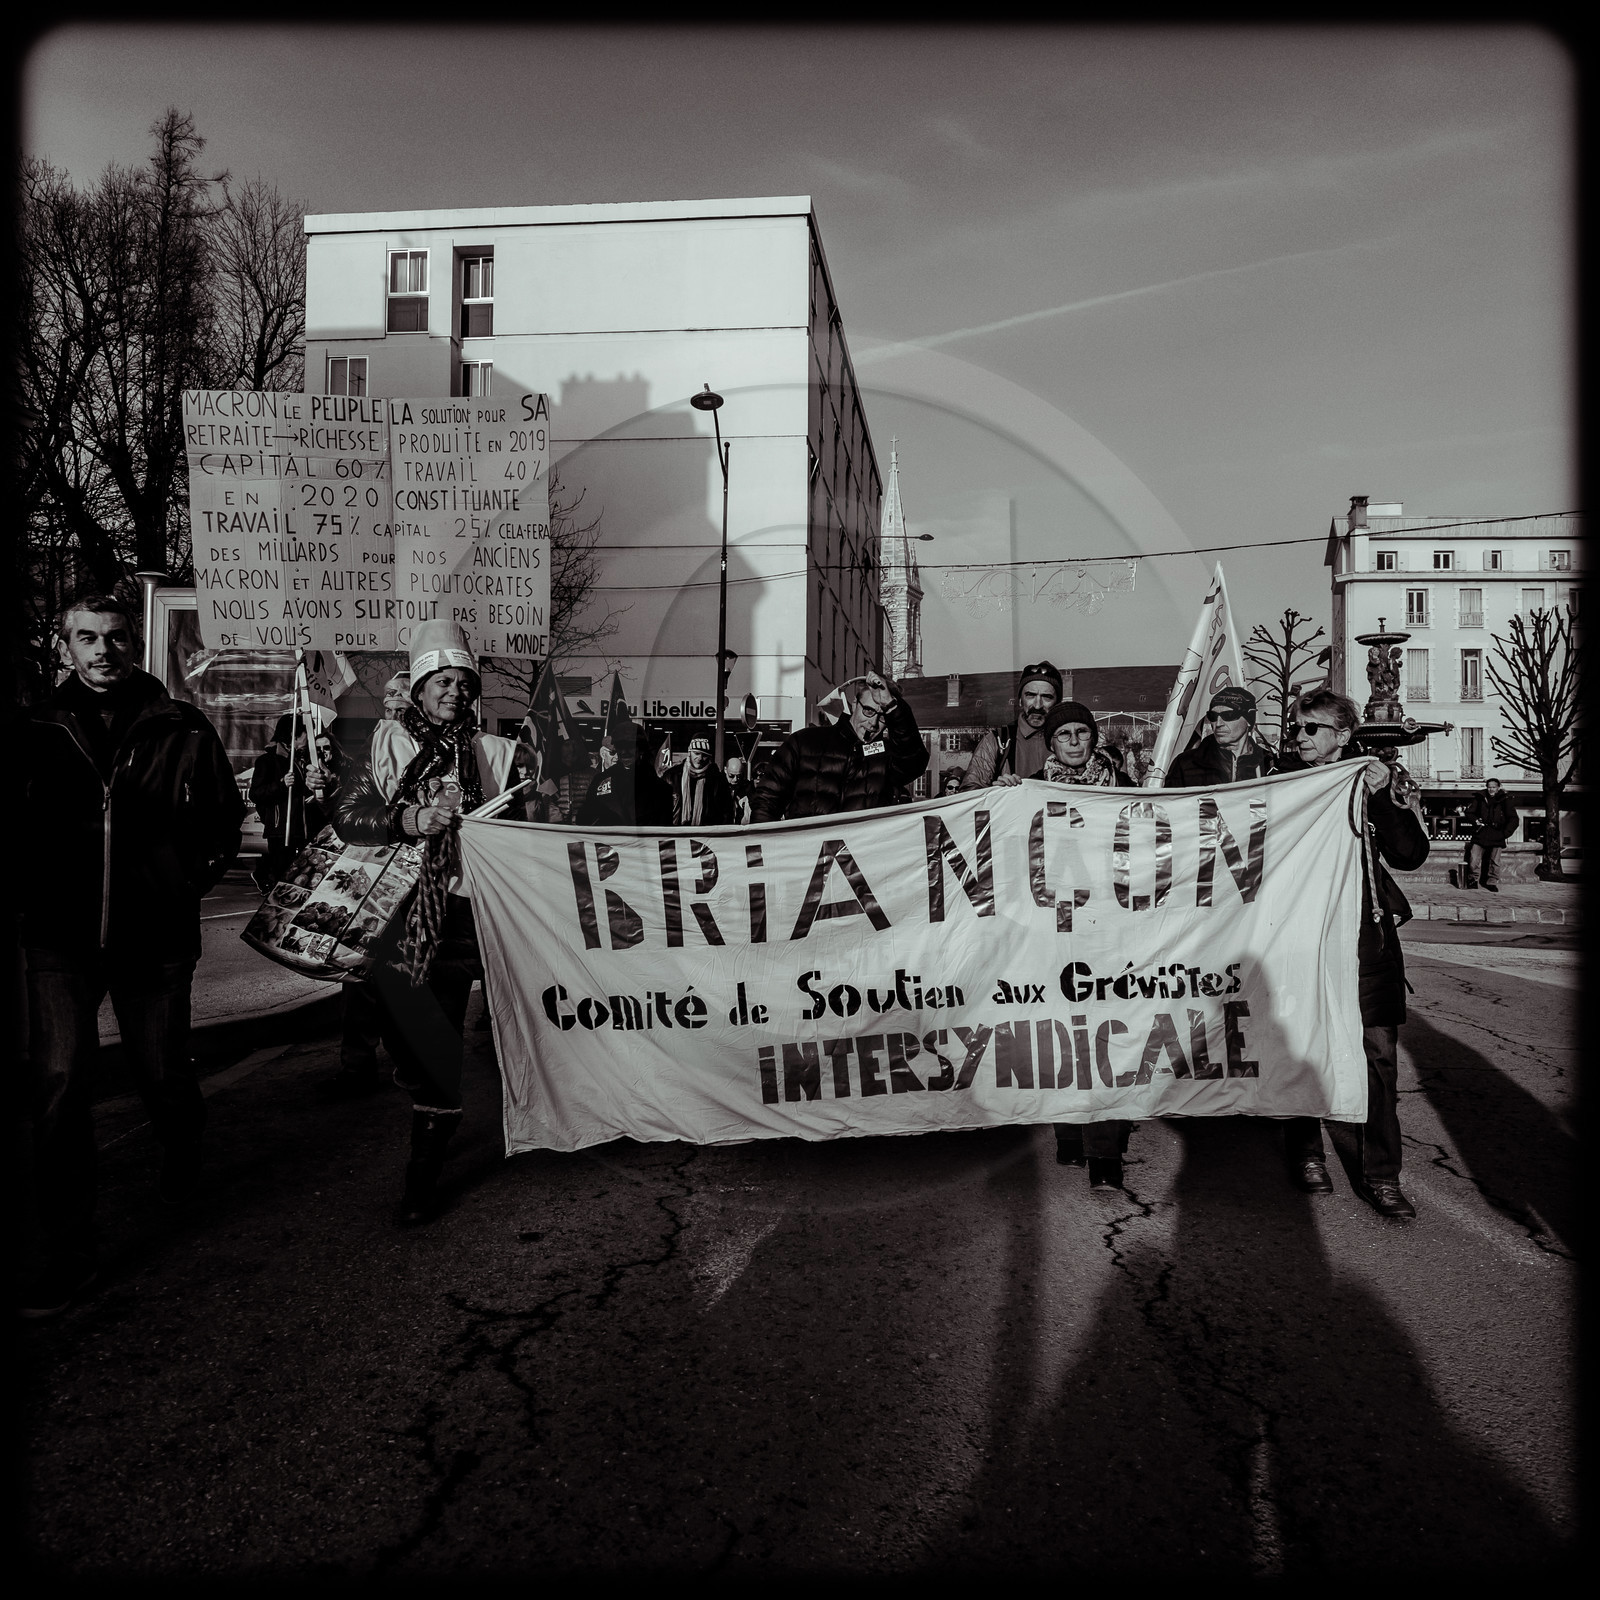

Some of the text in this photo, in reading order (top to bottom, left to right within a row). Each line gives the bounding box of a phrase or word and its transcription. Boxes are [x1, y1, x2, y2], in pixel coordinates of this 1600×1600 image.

[185, 391, 277, 419] MACRON
[283, 405, 302, 420] LE
[311, 396, 383, 423] PEUPLE
[391, 402, 414, 425] LA
[477, 409, 506, 423] POUR
[521, 393, 549, 421] SA
[488, 440, 502, 453] EN
[509, 429, 546, 452] 2019
[224, 491, 259, 506] EN
[301, 484, 379, 508] 2020
[210, 548, 240, 562] DES
[362, 552, 396, 565] POUR
[412, 550, 447, 565] NOS
[194, 568, 533, 598] MACRON ET AUTRES PLOUTOCRATES
[212, 600, 269, 620] NOUS
[282, 600, 342, 619] AVONS
[354, 599, 438, 621] SURTOUT
[452, 607, 478, 623] PAS
[221, 626, 548, 656] DE VOUS POUR LE MONDE
[643, 700, 717, 718] Libellule
[541, 985, 708, 1031] Comité
[728, 981, 770, 1026] de
[796, 968, 965, 1020] Soutien
[992, 978, 1046, 1005] aux
